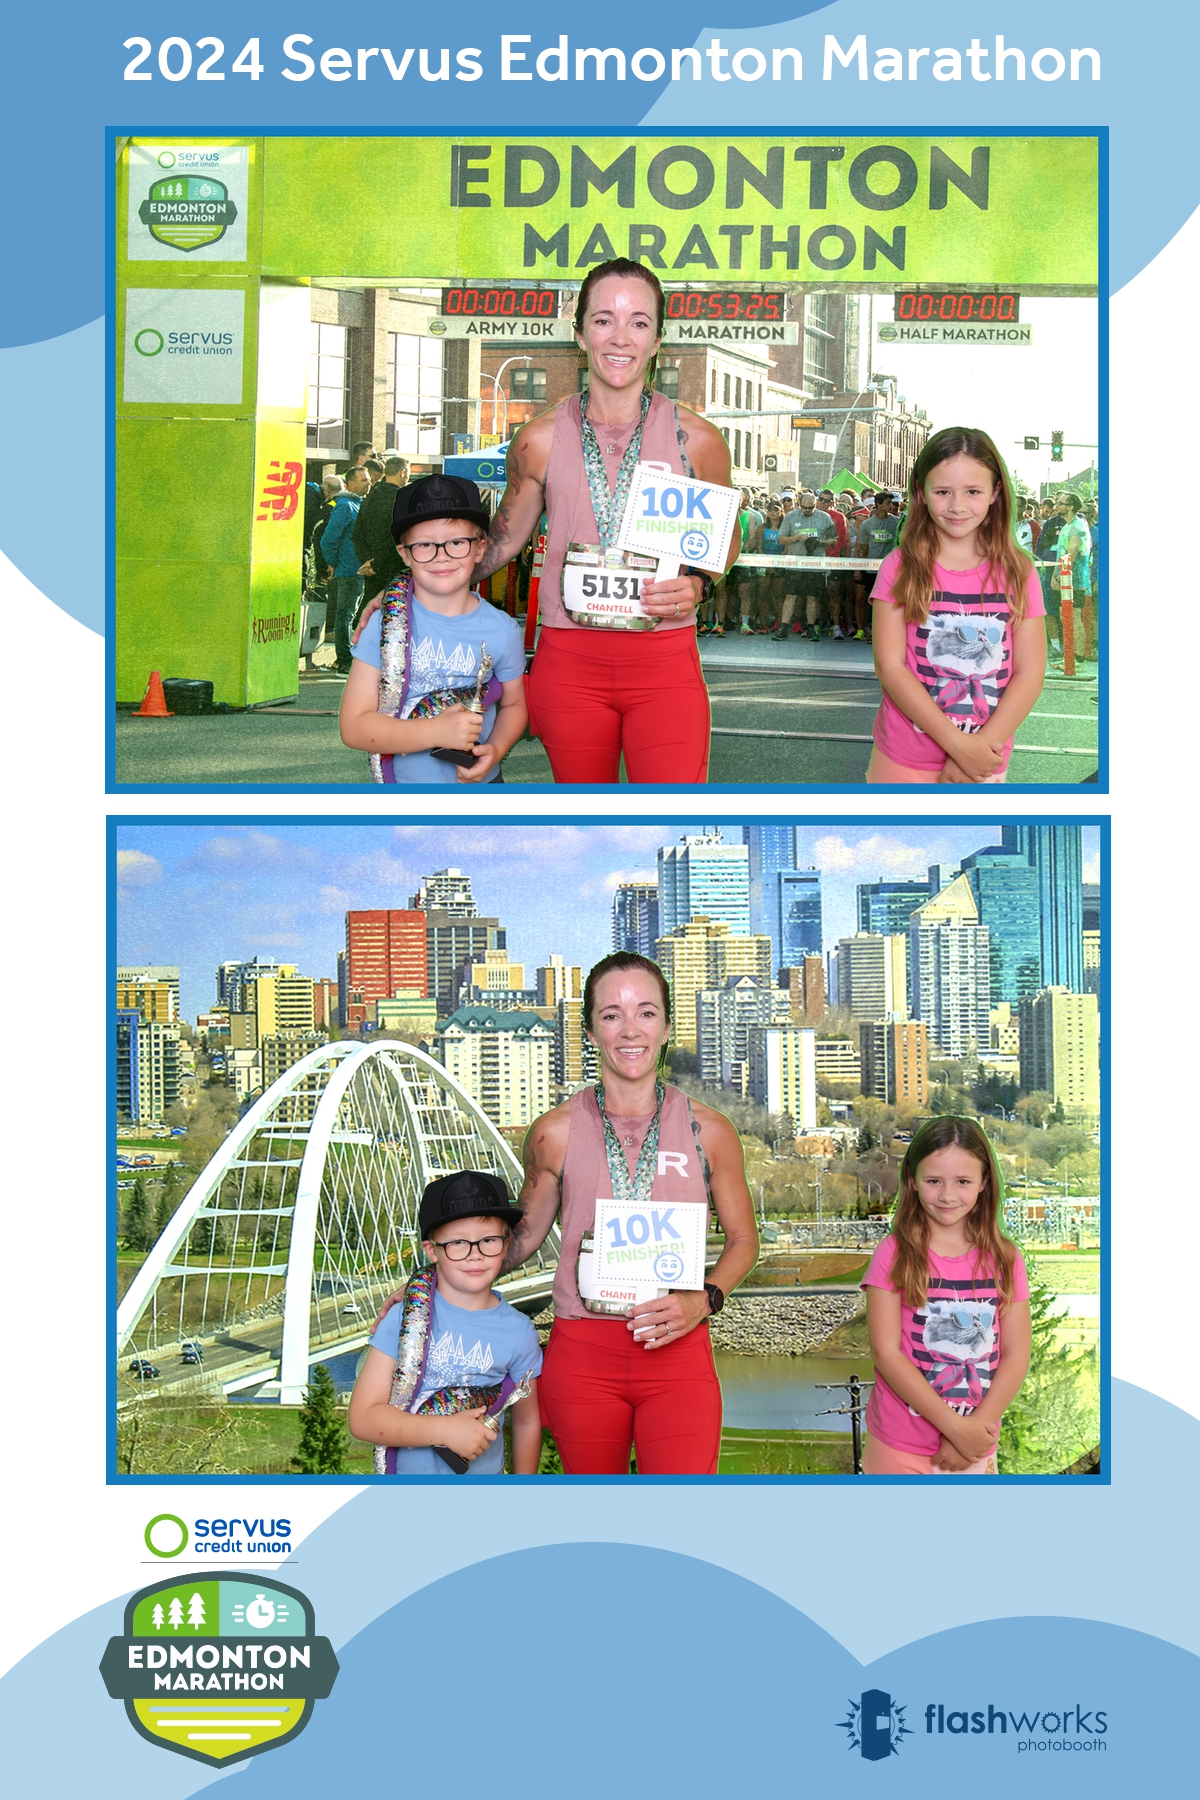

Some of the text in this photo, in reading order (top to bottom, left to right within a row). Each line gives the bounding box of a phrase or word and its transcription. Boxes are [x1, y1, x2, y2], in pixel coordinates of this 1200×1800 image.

[178, 152, 219, 161] servus
[449, 144, 991, 211] EDMONTON
[149, 202, 227, 214] EDMONTON
[160, 214, 215, 223] MARATHON
[523, 222, 907, 271] MARATHON
[465, 321, 555, 336] ARMY 10K
[678, 325, 785, 341] MARATHON
[900, 327, 1031, 341] HALF MARATHON
[168, 332, 233, 345] servus
[168, 345, 233, 355] credit union
[641, 486, 713, 520] 10K
[636, 519, 714, 536] FINISHER!
[581, 573, 641, 601] 5131
[586, 602, 634, 614] CHANTELL
[657, 1150, 690, 1178] R
[605, 1207, 682, 1249] 10K
[606, 1241, 686, 1264] FINISHER!
